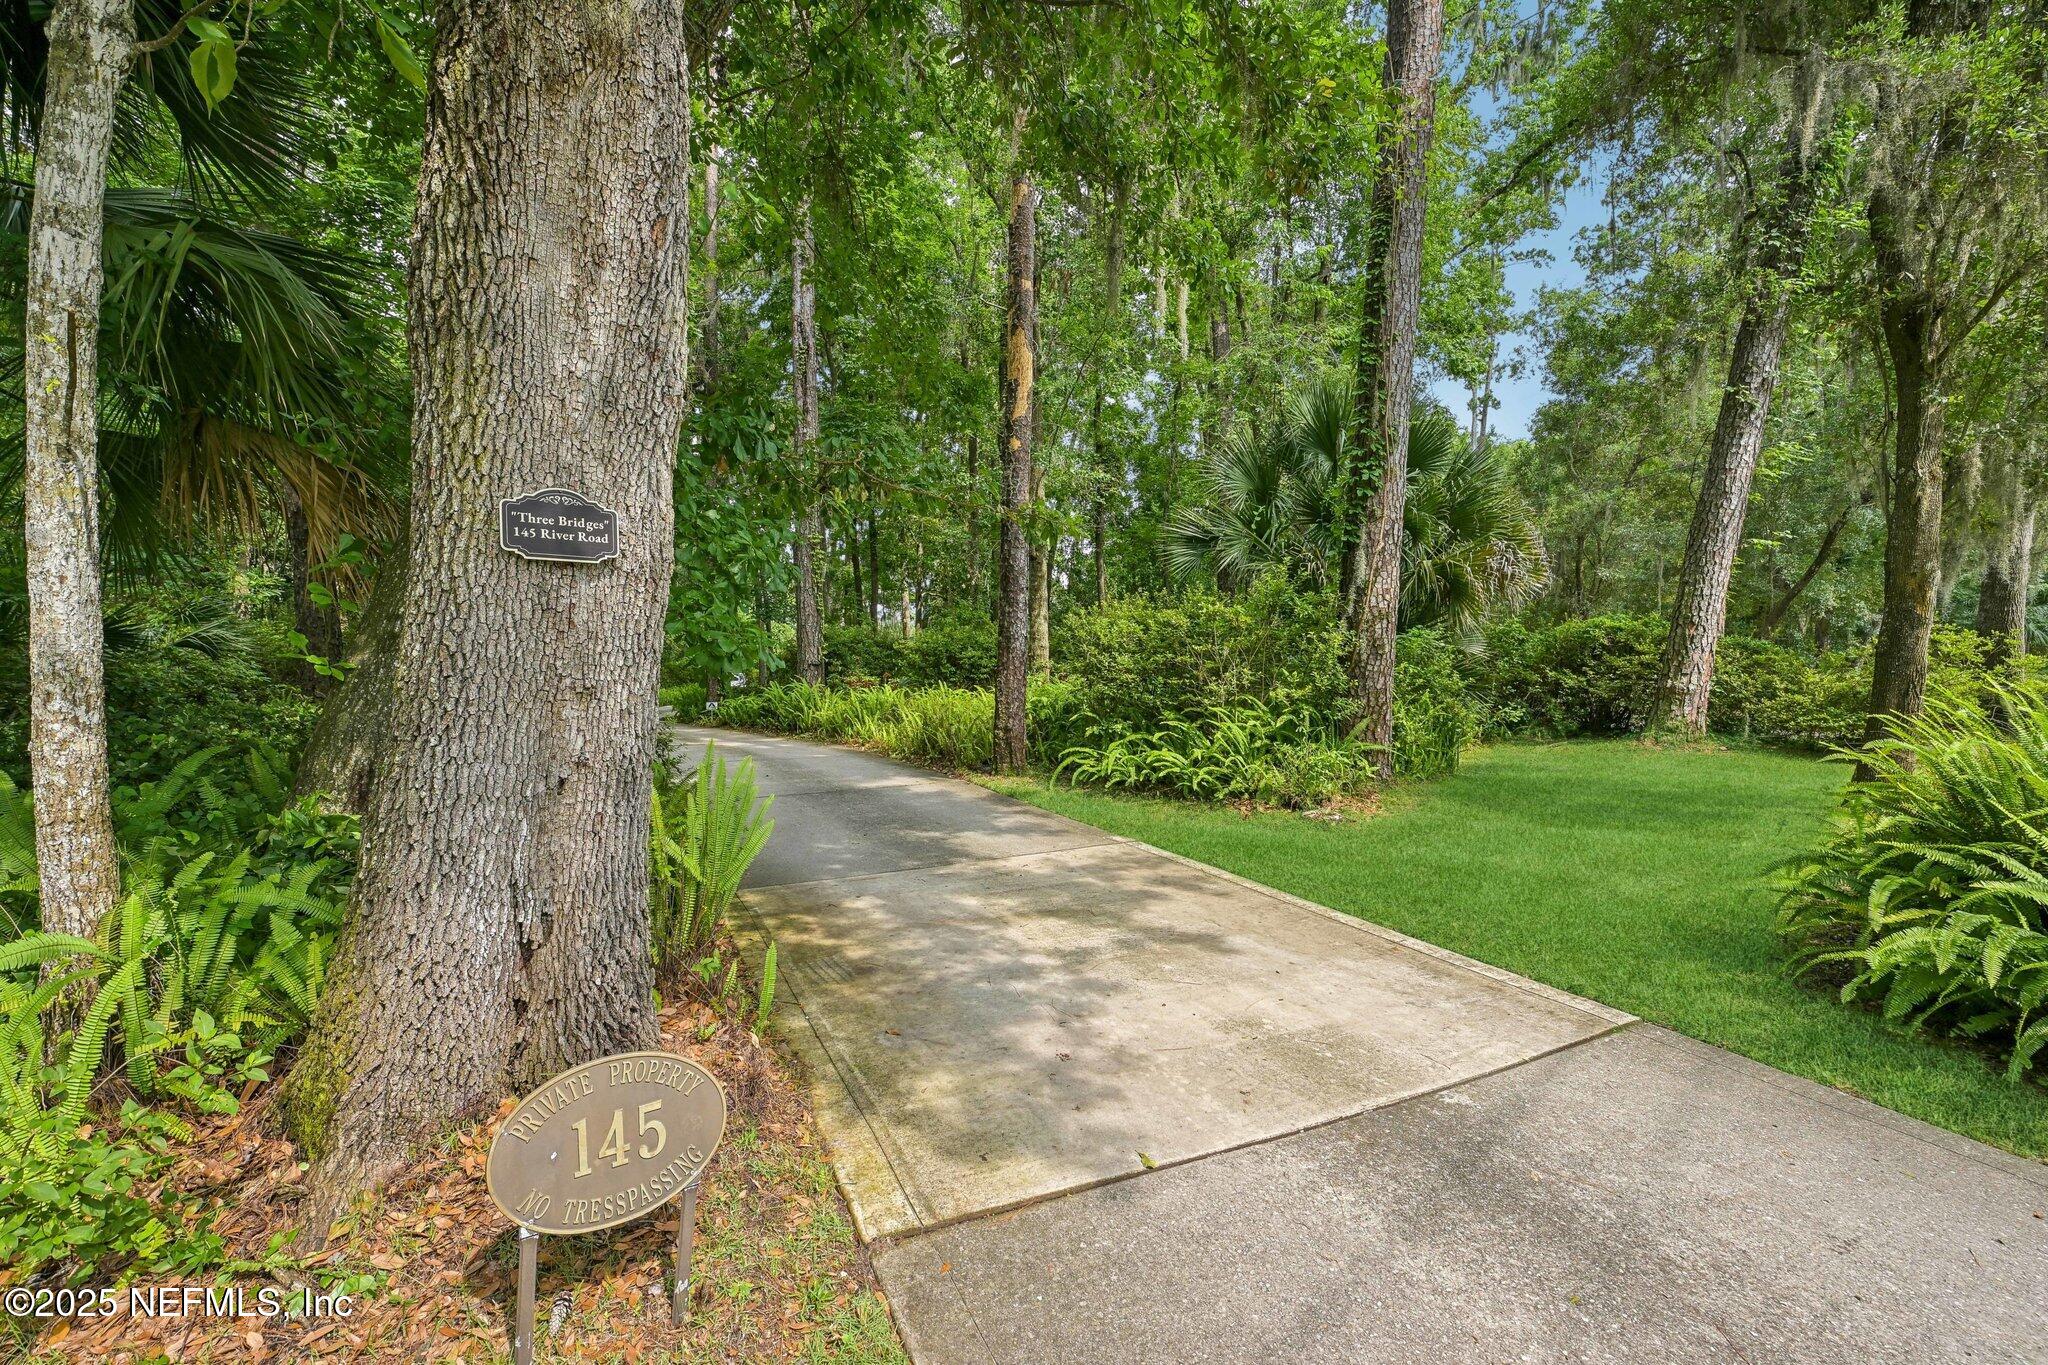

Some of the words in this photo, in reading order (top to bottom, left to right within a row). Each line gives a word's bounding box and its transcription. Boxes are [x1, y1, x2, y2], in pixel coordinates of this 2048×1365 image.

[511, 511, 555, 526] "Three
[559, 516, 609, 532] Bridges"
[513, 527, 536, 538] 145
[541, 529, 575, 541] River
[578, 532, 609, 544] Road
[509, 1072, 594, 1144] PRIVATE
[609, 1060, 705, 1097] PROPERTY
[571, 1099, 667, 1179] 145
[516, 1188, 551, 1220] NO
[562, 1144, 704, 1225] TRESSPASSING
